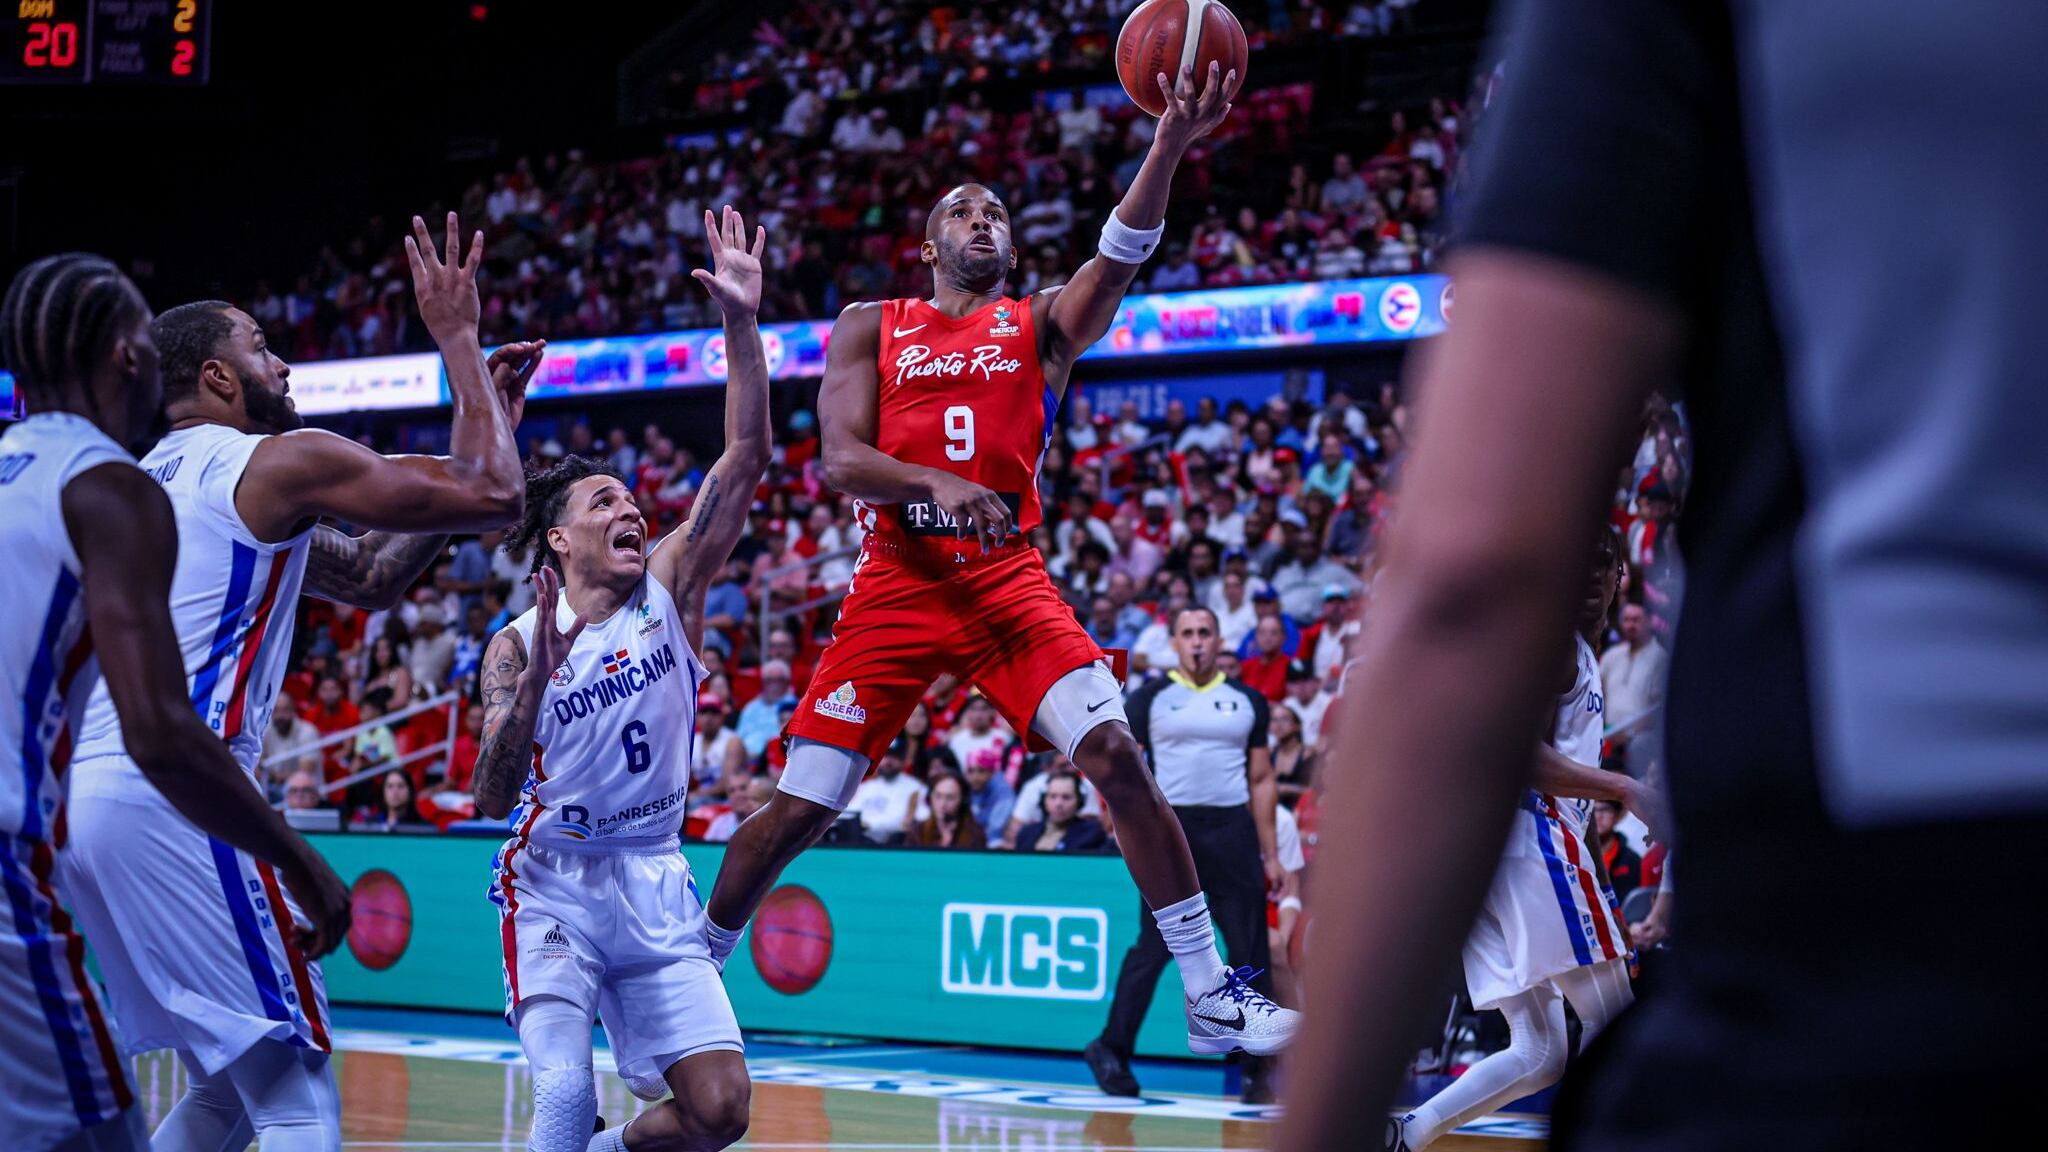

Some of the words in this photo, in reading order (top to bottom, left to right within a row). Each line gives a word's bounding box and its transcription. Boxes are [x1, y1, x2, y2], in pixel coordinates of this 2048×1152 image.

[173, 0, 196, 32] 2
[24, 22, 77, 67] 20
[171, 40, 195, 76] 2
[896, 344, 966, 386] Puerto
[969, 344, 1021, 381] Rico
[943, 405, 976, 462] 9
[553, 643, 677, 727] DOMINICANA
[815, 699, 866, 720] LOTERÍA
[621, 719, 651, 775] 6
[603, 825, 628, 836] banco
[950, 912, 1100, 991] MCS
